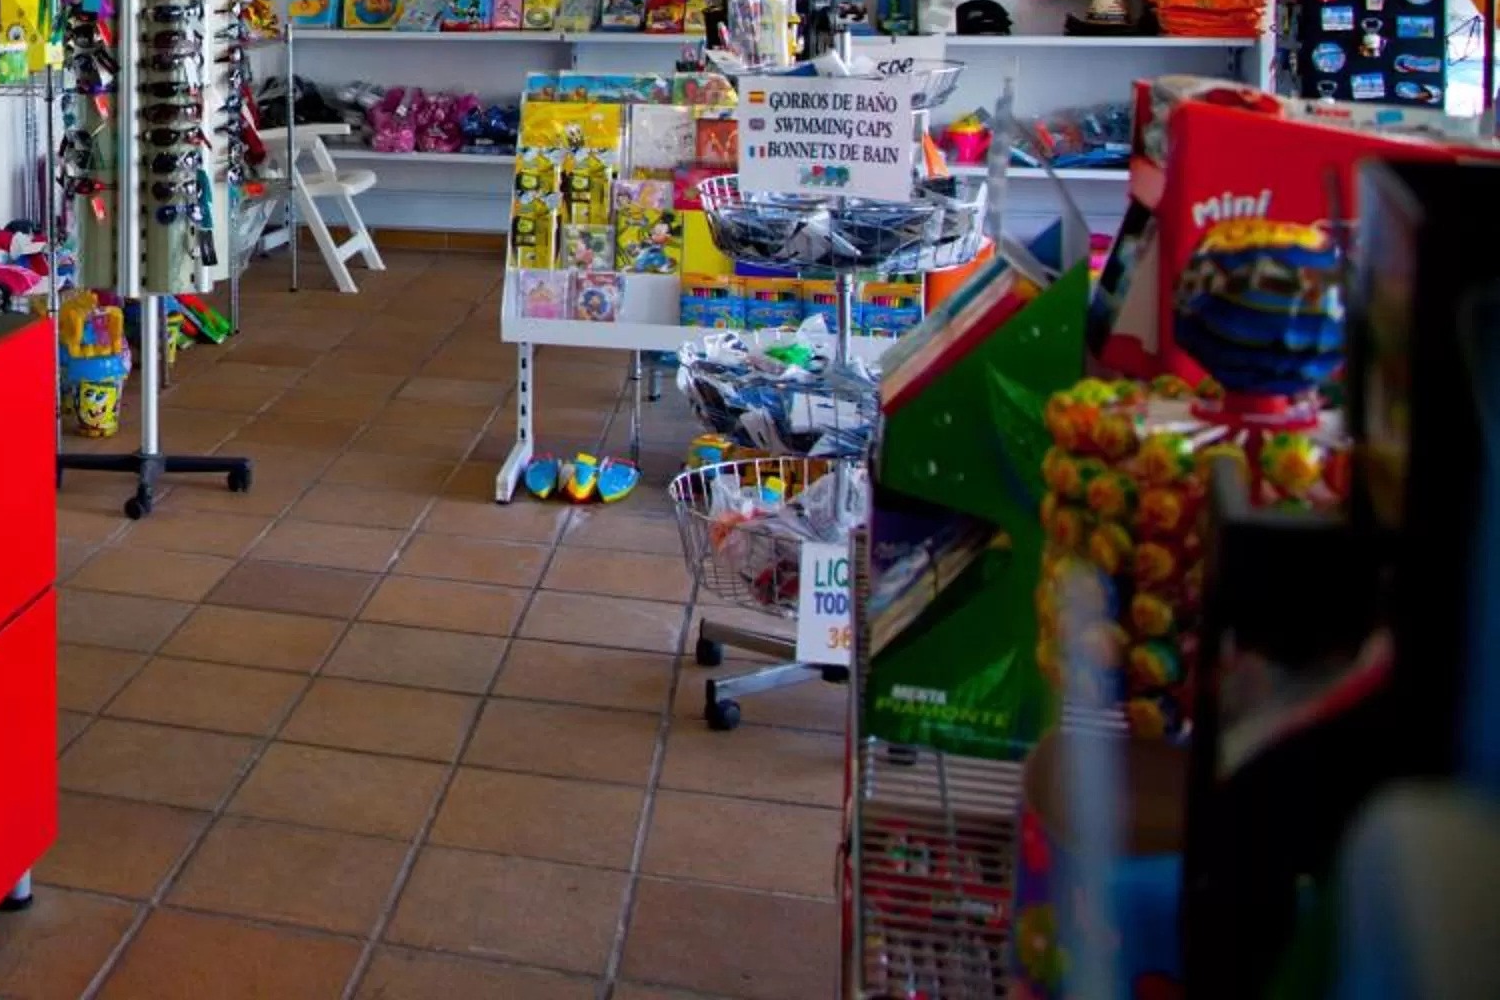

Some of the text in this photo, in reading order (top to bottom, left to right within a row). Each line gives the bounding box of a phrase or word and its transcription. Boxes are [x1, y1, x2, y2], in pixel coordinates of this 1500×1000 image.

[769, 91, 898, 114] GORROS DE BAÑO
[774, 117, 893, 139] SWIMMING CAPS
[767, 141, 899, 164] BONNETS DE BAIN
[813, 591, 851, 615] TOD
